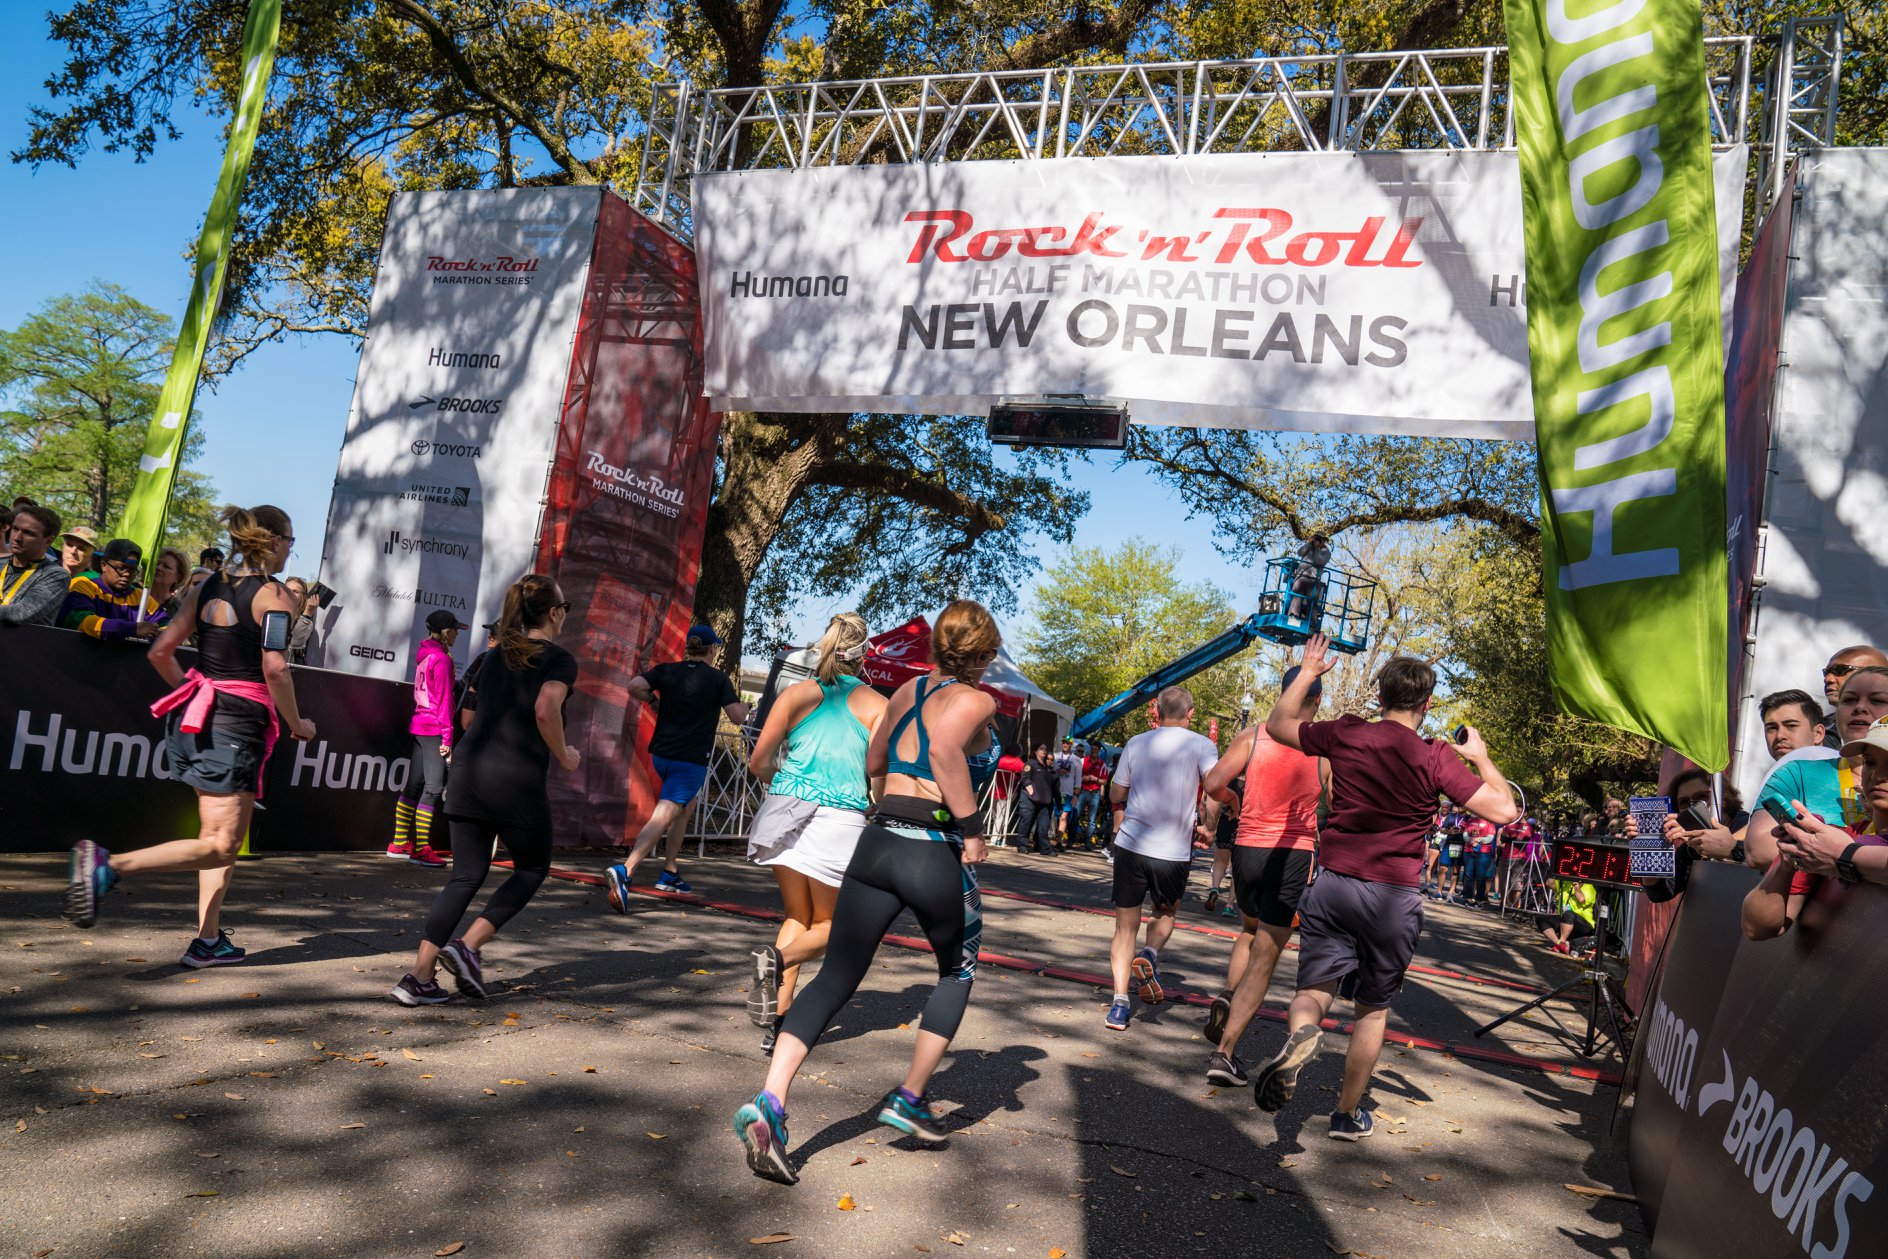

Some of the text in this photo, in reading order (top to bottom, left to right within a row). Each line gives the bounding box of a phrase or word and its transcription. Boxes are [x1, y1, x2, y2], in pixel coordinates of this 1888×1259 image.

[904, 210, 1129, 264] Rock
[1212, 207, 1425, 269] Roll
[427, 256, 478, 272] Rock
[496, 256, 539, 272] Roll
[433, 276, 531, 285] MARATHON SERIES
[731, 271, 849, 298] Humana
[972, 264, 1327, 306] HALF MARATHON
[897, 299, 1409, 368] NEW ORLEANS
[428, 347, 501, 369] Humana
[437, 397, 502, 414] BROOKS
[432, 443, 481, 458] TOYOTA
[411, 484, 451, 494] UNITED
[587, 450, 635, 486] Rock
[649, 475, 685, 506] Roll
[399, 493, 449, 504] AIRLINES
[592, 478, 679, 519] MARATHON SERIES
[401, 537, 469, 560] synchrony
[372, 586, 467, 610] Michelob ULTRA
[350, 645, 396, 663] GEICO
[290, 740, 411, 792] Huma
[1558, 845, 1643, 886] 2:21:1
[1723, 1076, 1875, 1259] BROOKS
